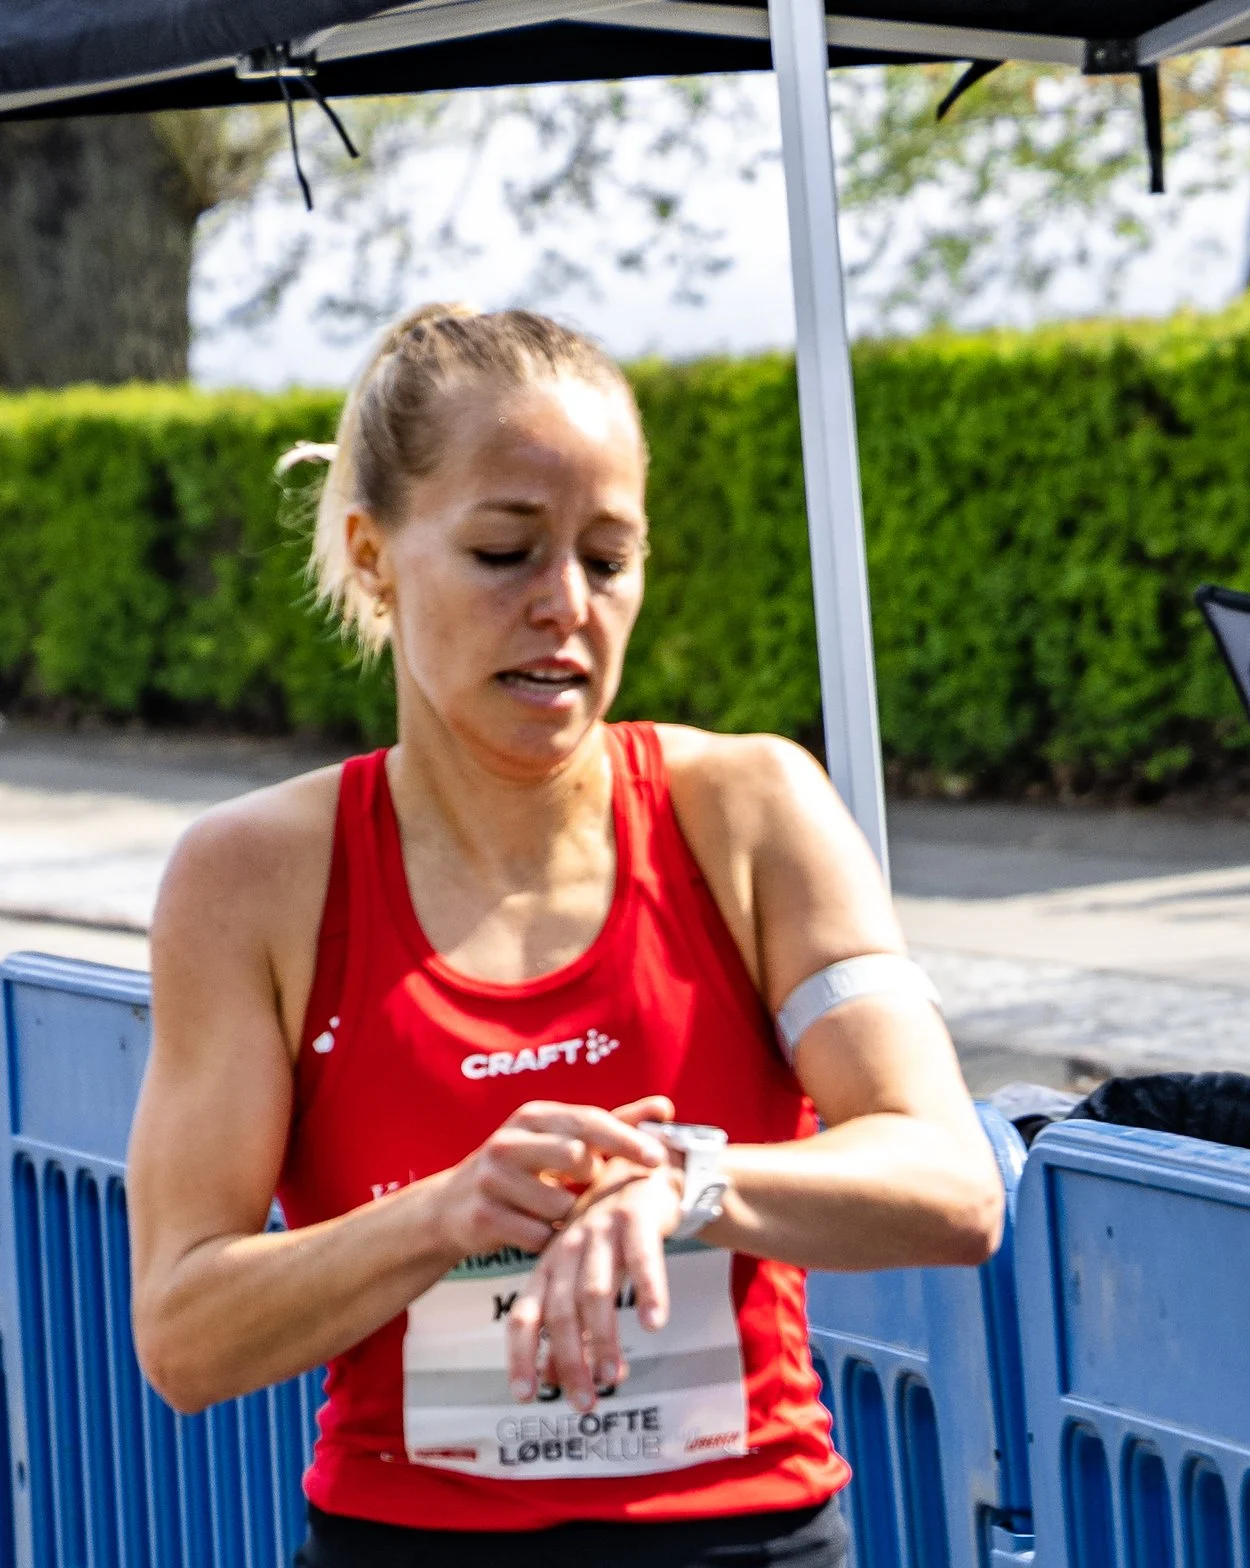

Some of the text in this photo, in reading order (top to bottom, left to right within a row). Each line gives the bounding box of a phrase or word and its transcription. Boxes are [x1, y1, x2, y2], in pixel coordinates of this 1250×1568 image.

[461, 1037, 584, 1080] CRAFT
[496, 1406, 660, 1446] GENTOFTE
[498, 1434, 661, 1466] LØBEKLUB
